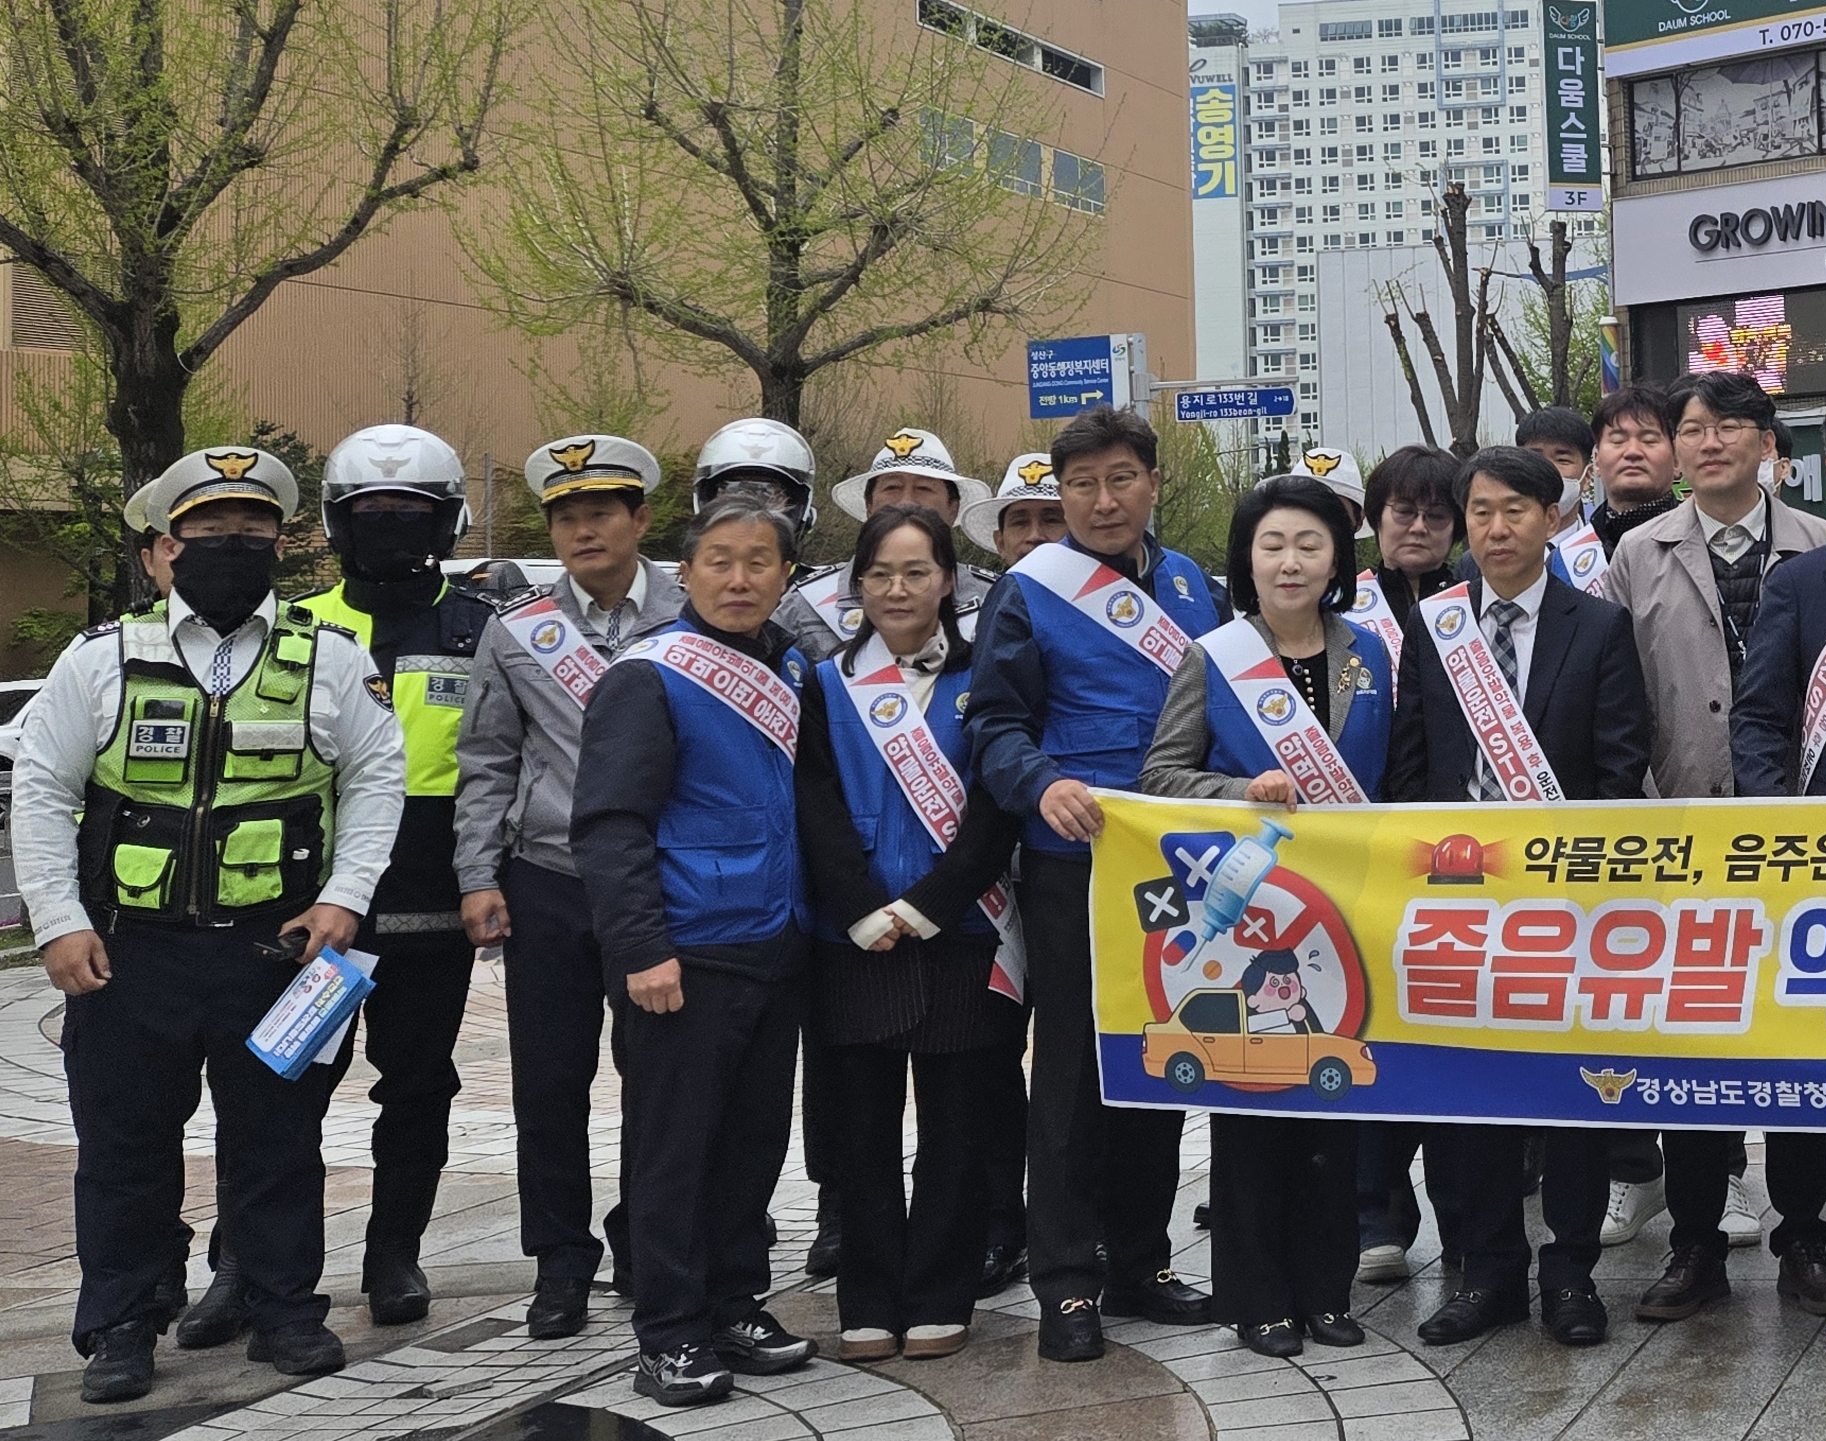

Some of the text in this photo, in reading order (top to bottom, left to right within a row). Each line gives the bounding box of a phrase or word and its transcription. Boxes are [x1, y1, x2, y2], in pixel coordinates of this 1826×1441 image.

[1658, 9, 1732, 32] DAUM SCHOOL
[1759, 29, 1773, 46] T.
[1557, 46, 1588, 173] 다움스쿨
[1195, 87, 1236, 196] 송영기
[1564, 191, 1588, 206] 3F
[135, 744, 182, 755] POLICE
[1522, 833, 1705, 885] 약물운전,
[1400, 906, 1765, 1024] 졸음유발
